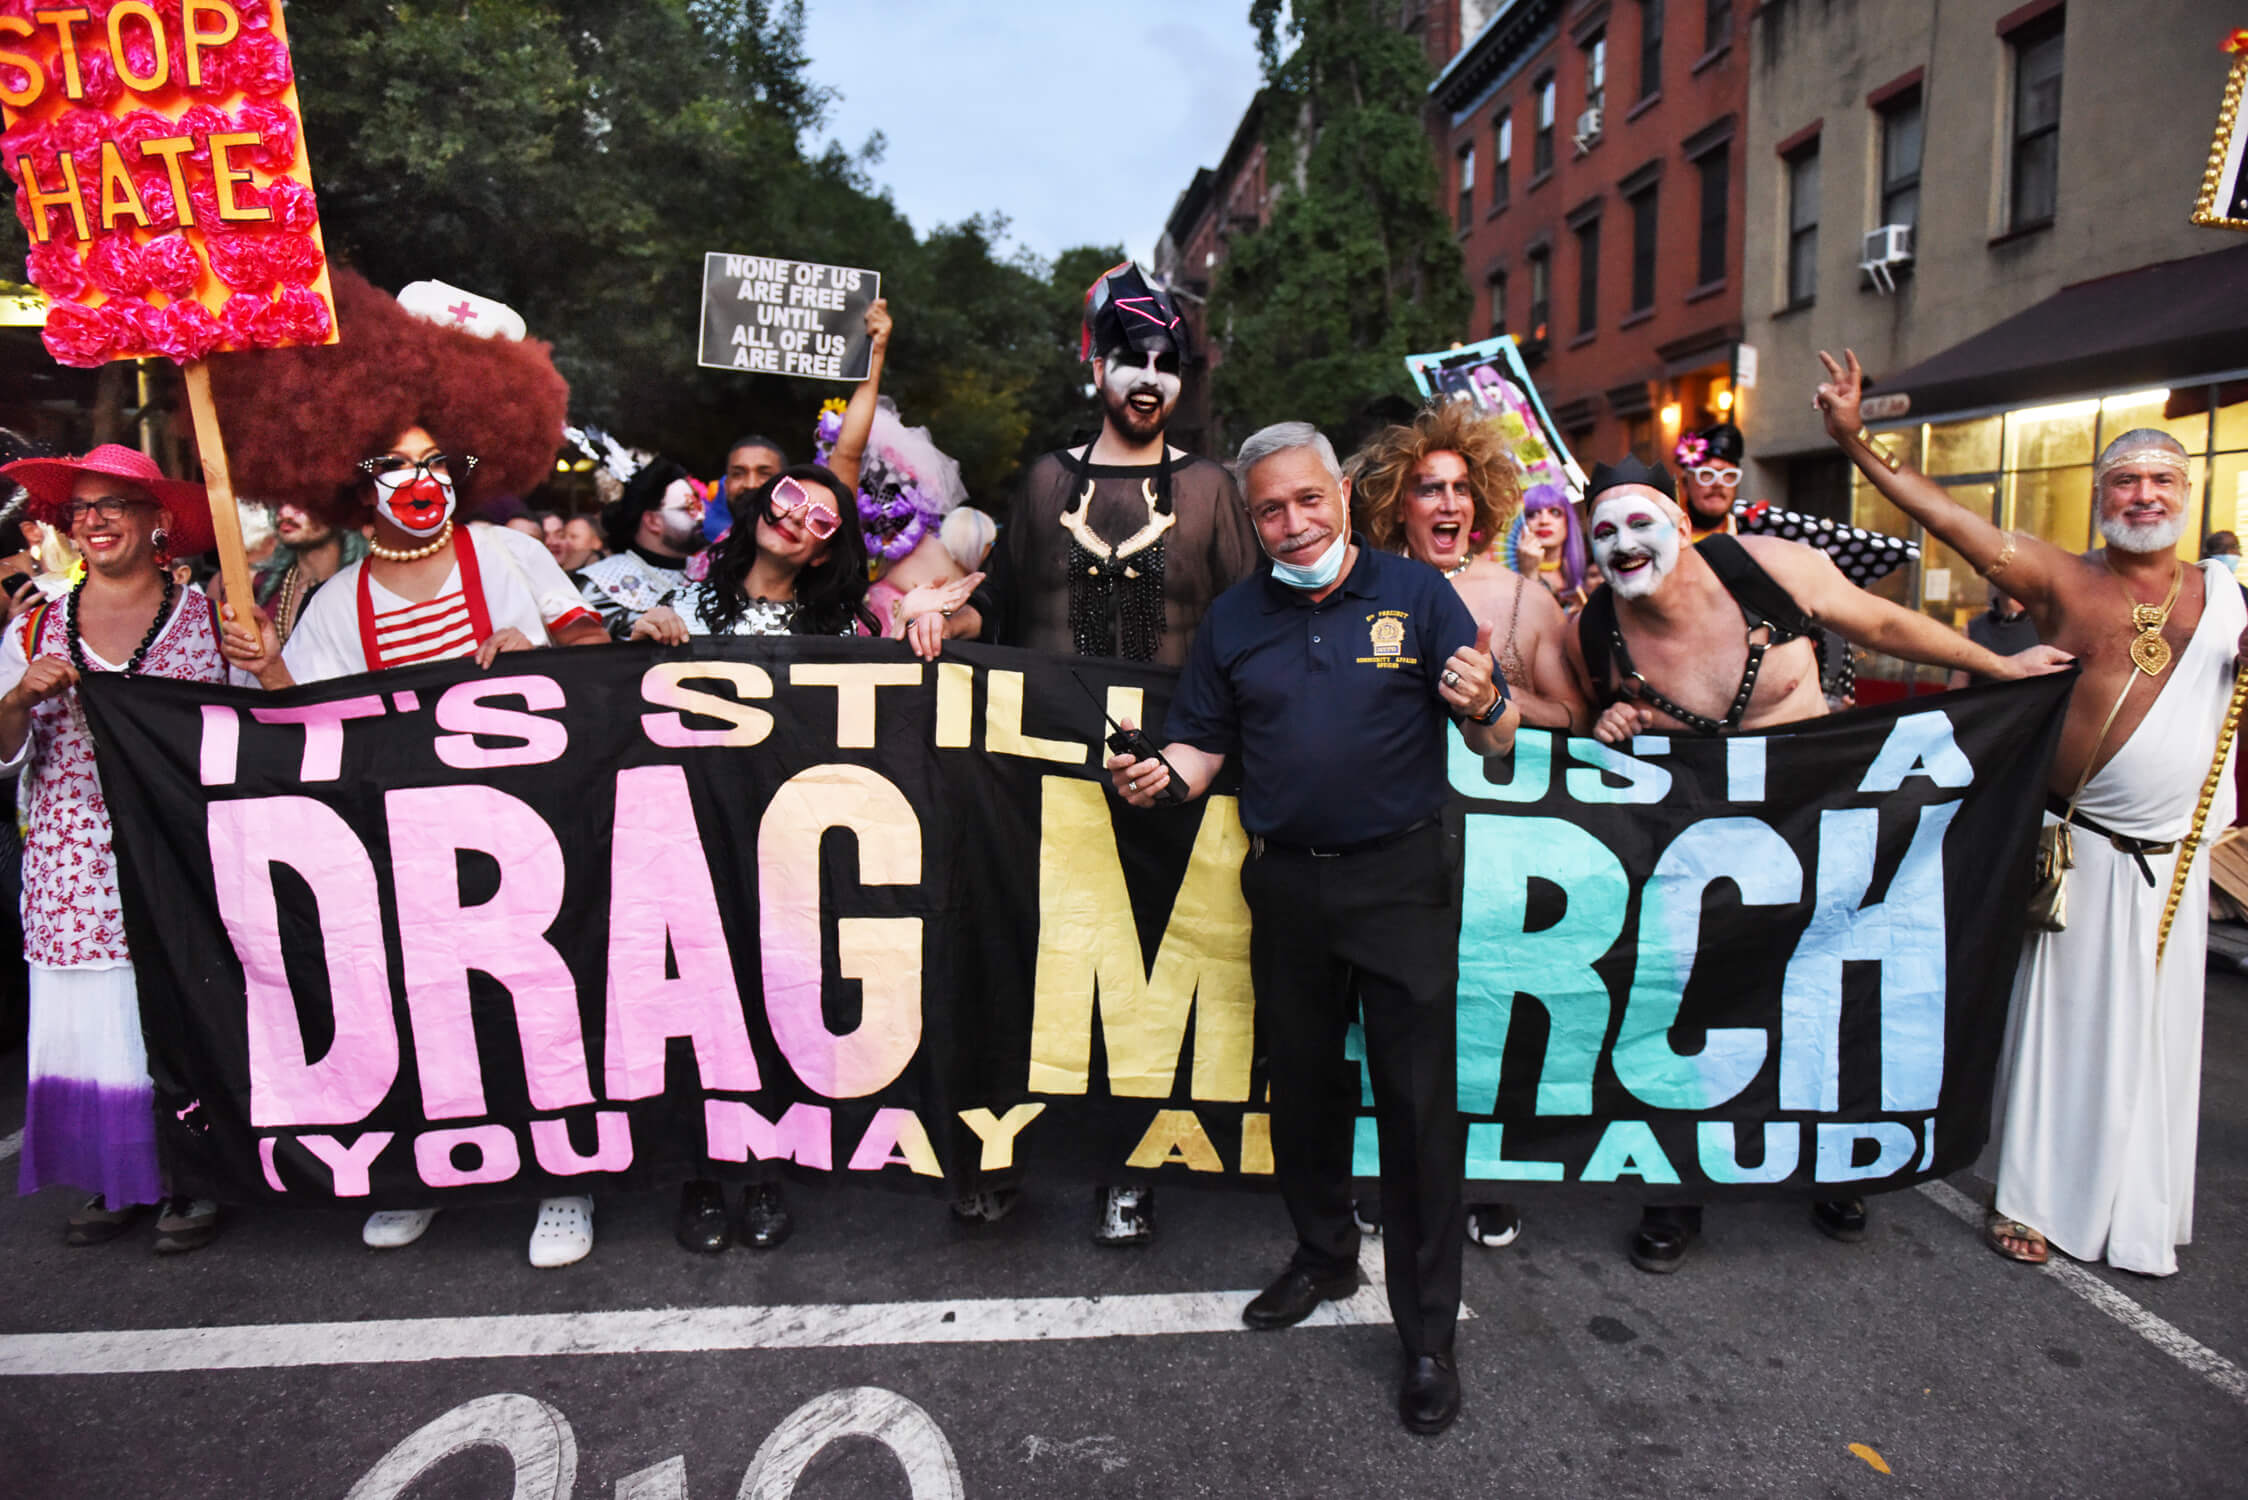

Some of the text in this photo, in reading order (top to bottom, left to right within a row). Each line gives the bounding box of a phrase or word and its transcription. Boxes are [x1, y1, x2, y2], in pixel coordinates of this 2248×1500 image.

[0, 0, 240, 107] STOP
[17, 131, 274, 244] HATE
[726, 256, 860, 290] NONE OF US
[737, 281, 845, 310] ARE FREE
[731, 325, 845, 355] ALL OF US
[757, 304, 823, 330] UNTIL
[733, 347, 840, 376] ARE FREE
[200, 675, 569, 786] IT'S
[1856, 710, 1974, 793] A
[207, 763, 1965, 1128] DRAG MRCH
[703, 1098, 1048, 1178] MAY
